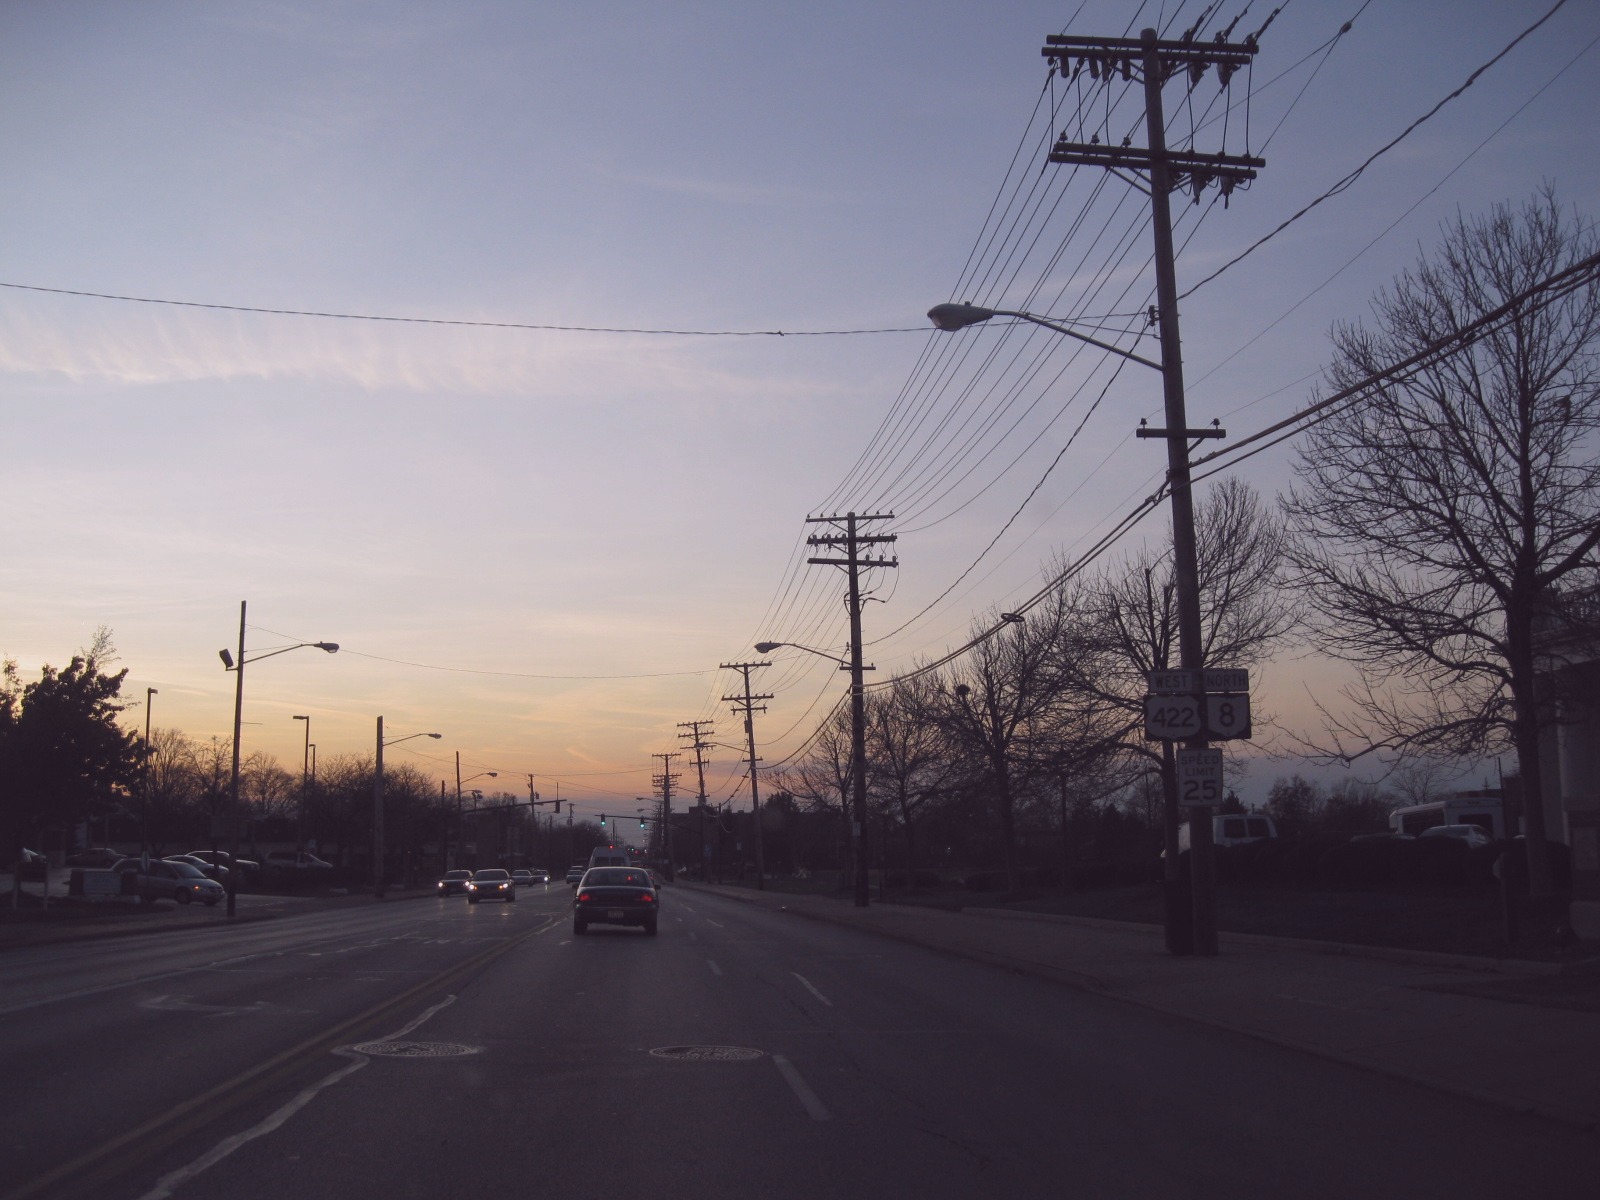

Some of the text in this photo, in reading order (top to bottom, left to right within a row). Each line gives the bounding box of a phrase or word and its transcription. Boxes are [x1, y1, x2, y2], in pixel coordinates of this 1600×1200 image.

[1155, 674, 1187, 688] WEST
[1206, 673, 1246, 687] NORTH
[1151, 707, 1195, 728] 422
[1220, 702, 1235, 727] 8
[1181, 755, 1219, 765] SPEED
[1185, 767, 1215, 777] LIMIT
[1183, 780, 1217, 800] 25
